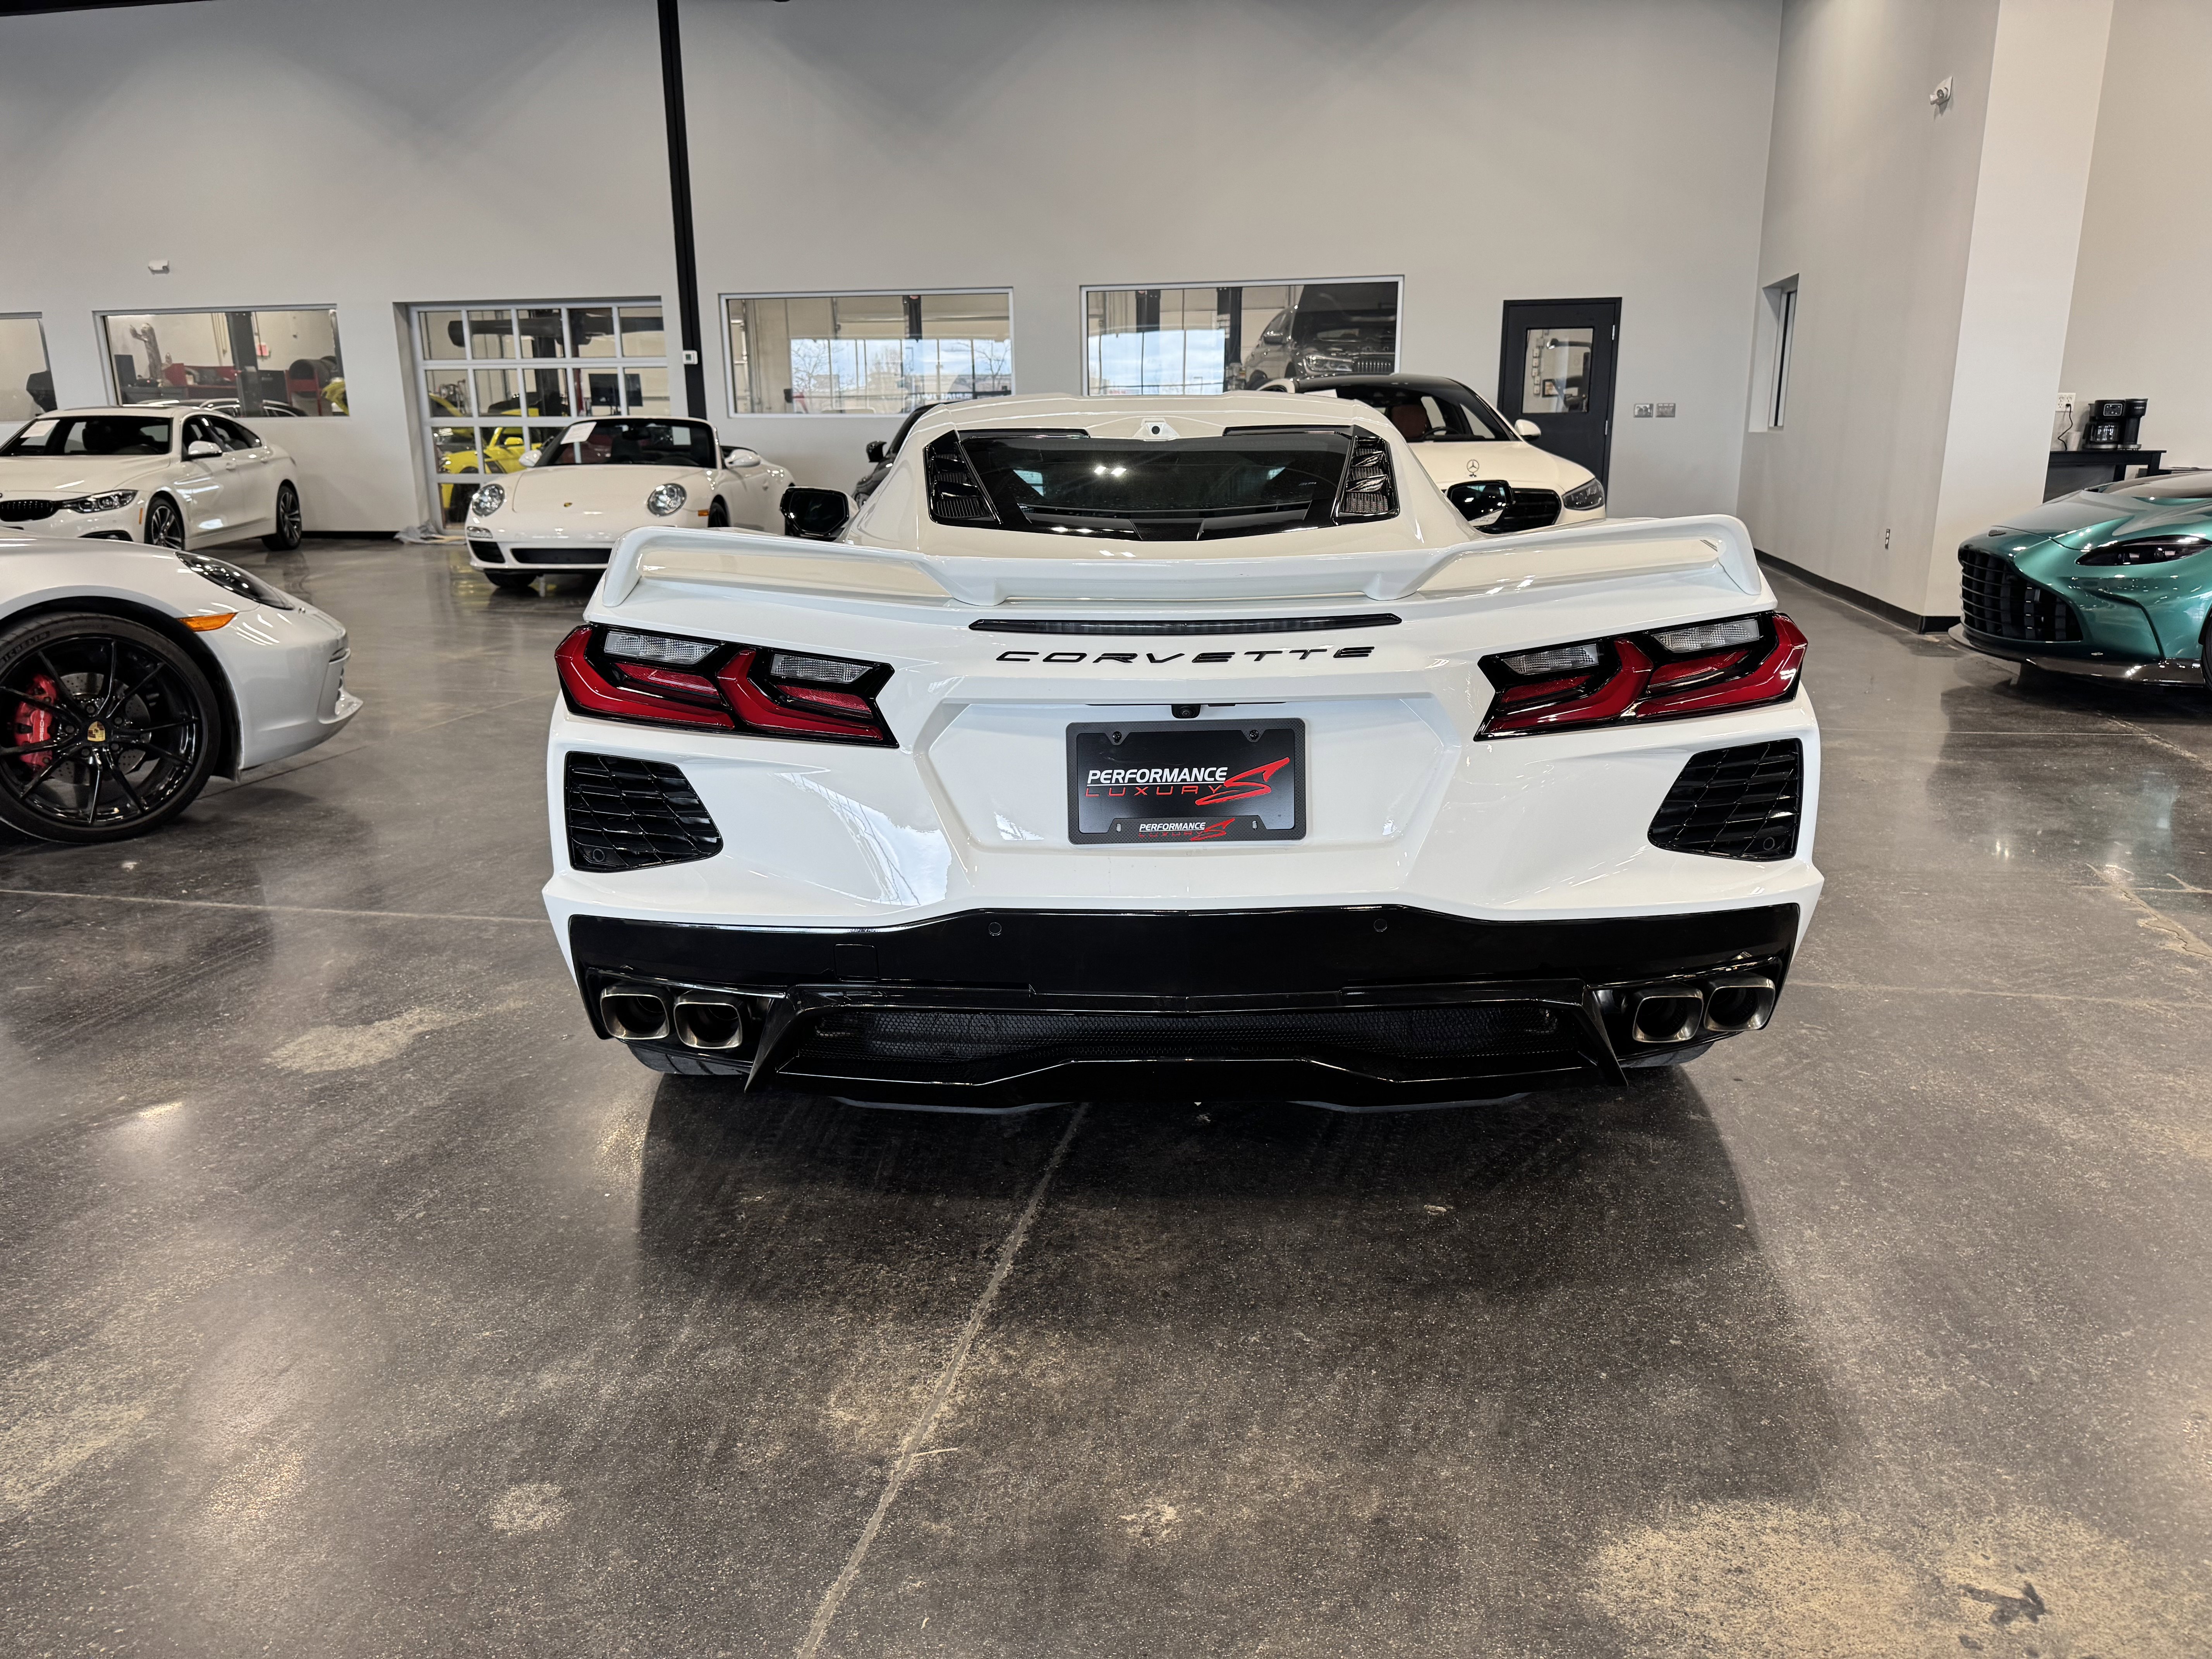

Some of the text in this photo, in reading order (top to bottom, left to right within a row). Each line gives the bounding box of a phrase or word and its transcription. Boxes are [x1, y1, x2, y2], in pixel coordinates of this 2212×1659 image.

[996, 646, 1374, 663] CORVETTE
[1087, 767, 1228, 784] PERFORMANCE
[1085, 785, 1222, 797] LUXURY
[1139, 822, 1206, 831] PERFORMANCE
